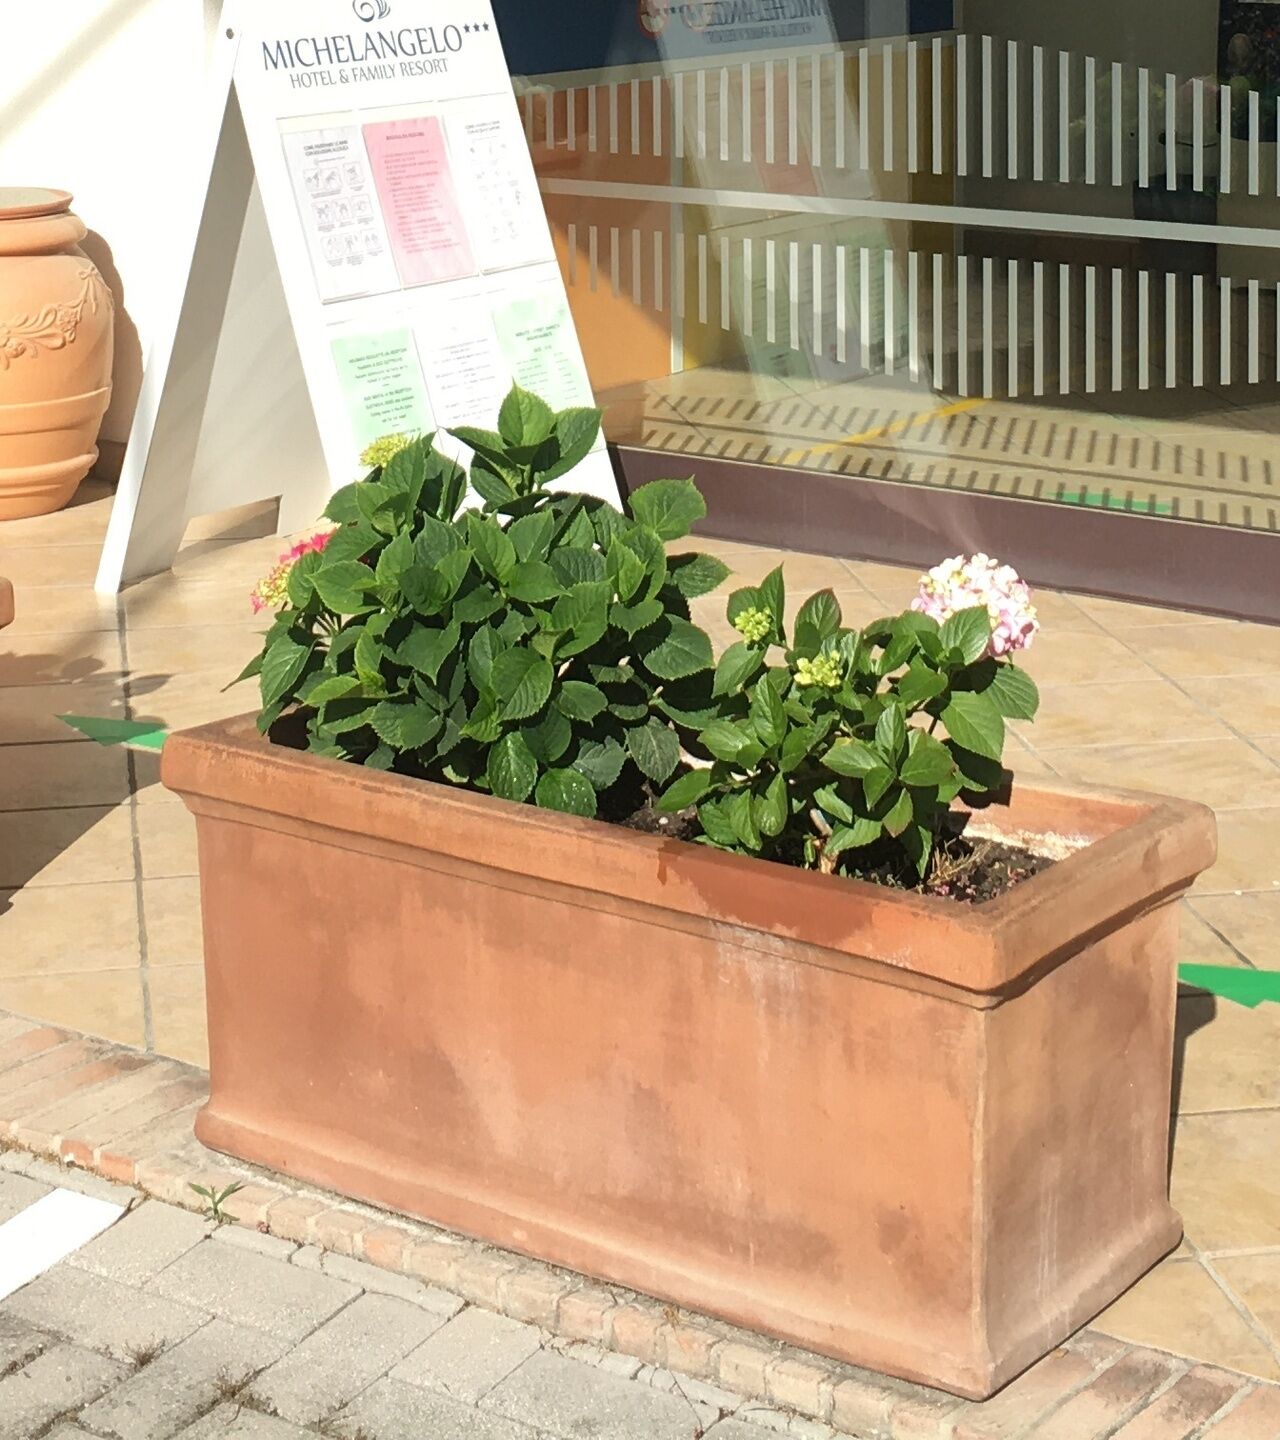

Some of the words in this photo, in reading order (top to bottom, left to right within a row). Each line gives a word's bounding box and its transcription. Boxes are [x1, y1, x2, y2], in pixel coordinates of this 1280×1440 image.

[262, 23, 464, 72] MICHELANGELO
[290, 68, 337, 89] HOTEL
[339, 67, 350, 85] &
[352, 63, 398, 84] FAMILY
[400, 58, 449, 79] RESORT
